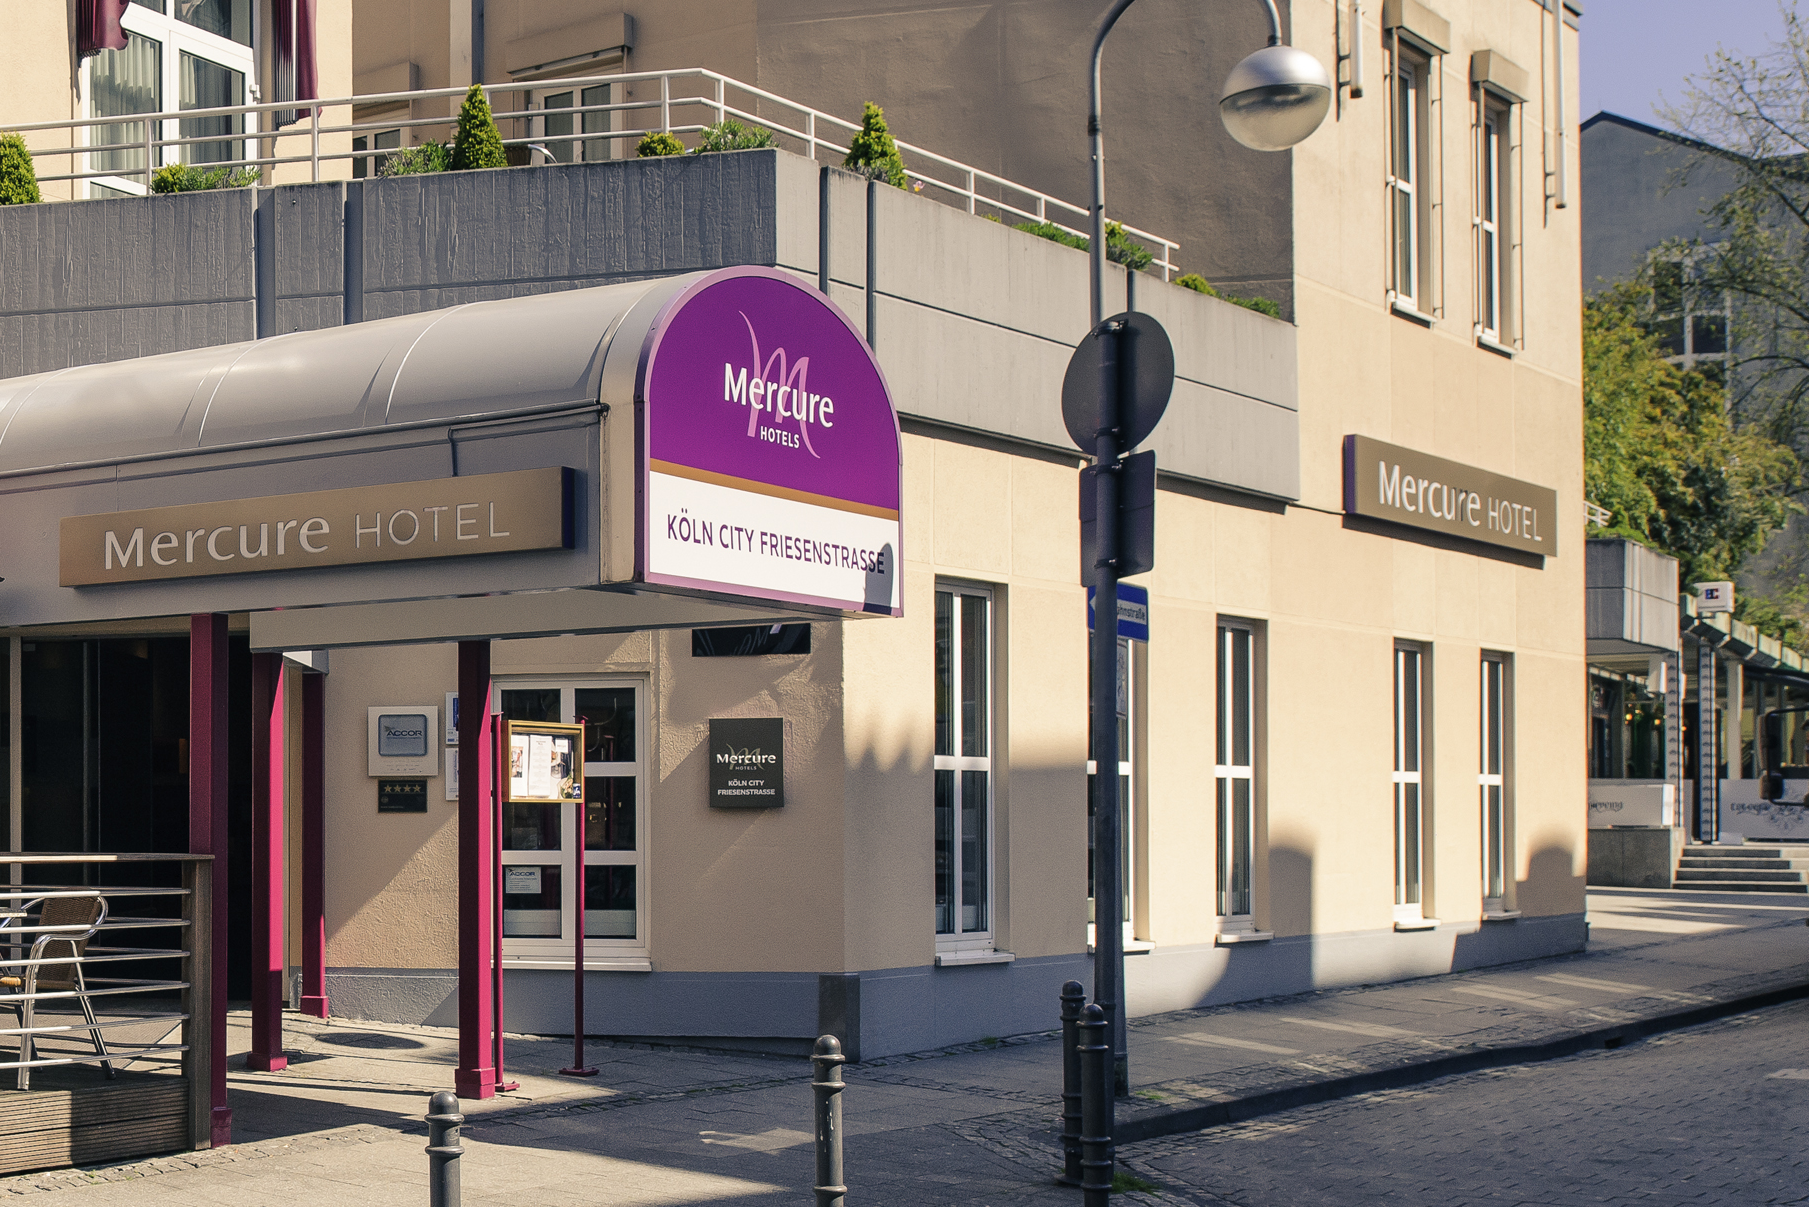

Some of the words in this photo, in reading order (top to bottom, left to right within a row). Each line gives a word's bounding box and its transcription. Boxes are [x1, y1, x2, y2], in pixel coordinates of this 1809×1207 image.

[723, 362, 834, 428] Mercure
[760, 425, 800, 449] HOTELS
[1378, 460, 1481, 527] Mercure
[1488, 496, 1543, 541] HOTEL
[104, 516, 330, 570] Mercure
[354, 501, 510, 549] HOTEL
[667, 507, 713, 546] KÖLN
[719, 524, 754, 552] CITY
[760, 531, 885, 574] FRIESENSTRASSE
[716, 753, 777, 764] Mercure
[728, 778, 747, 787] KÖLN
[748, 779, 765, 787] CITY
